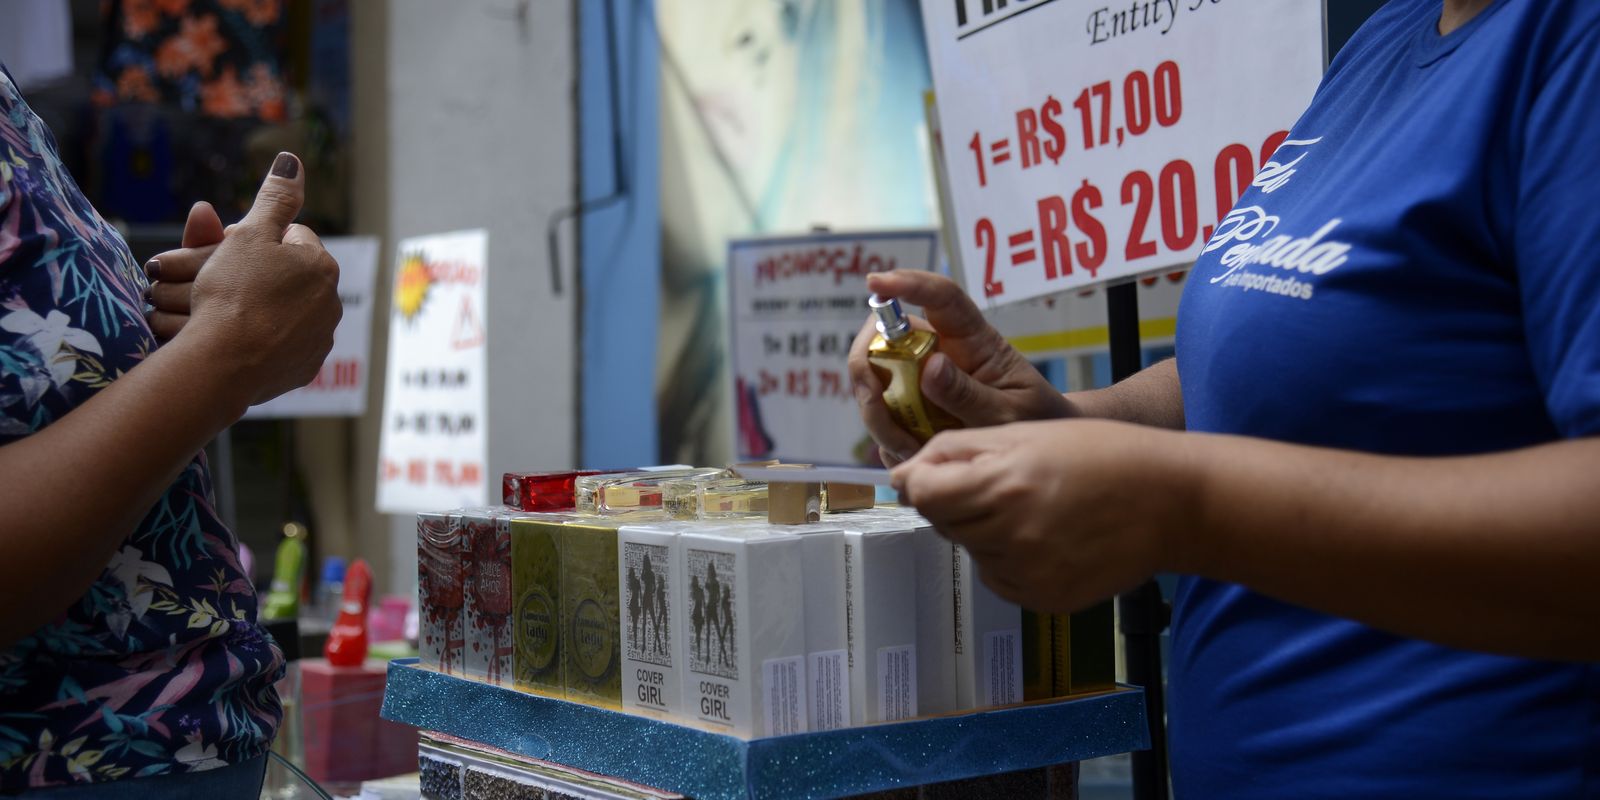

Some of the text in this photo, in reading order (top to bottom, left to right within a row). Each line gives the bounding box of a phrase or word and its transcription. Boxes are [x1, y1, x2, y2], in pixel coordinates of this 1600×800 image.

[1086, 0, 1179, 46] Entity
[1015, 95, 1067, 170] R$
[1073, 60, 1183, 150] 17,00
[636, 669, 664, 686] COVER
[637, 684, 666, 706] GIRL
[700, 681, 730, 699] COVER
[700, 697, 731, 720] GIRL
